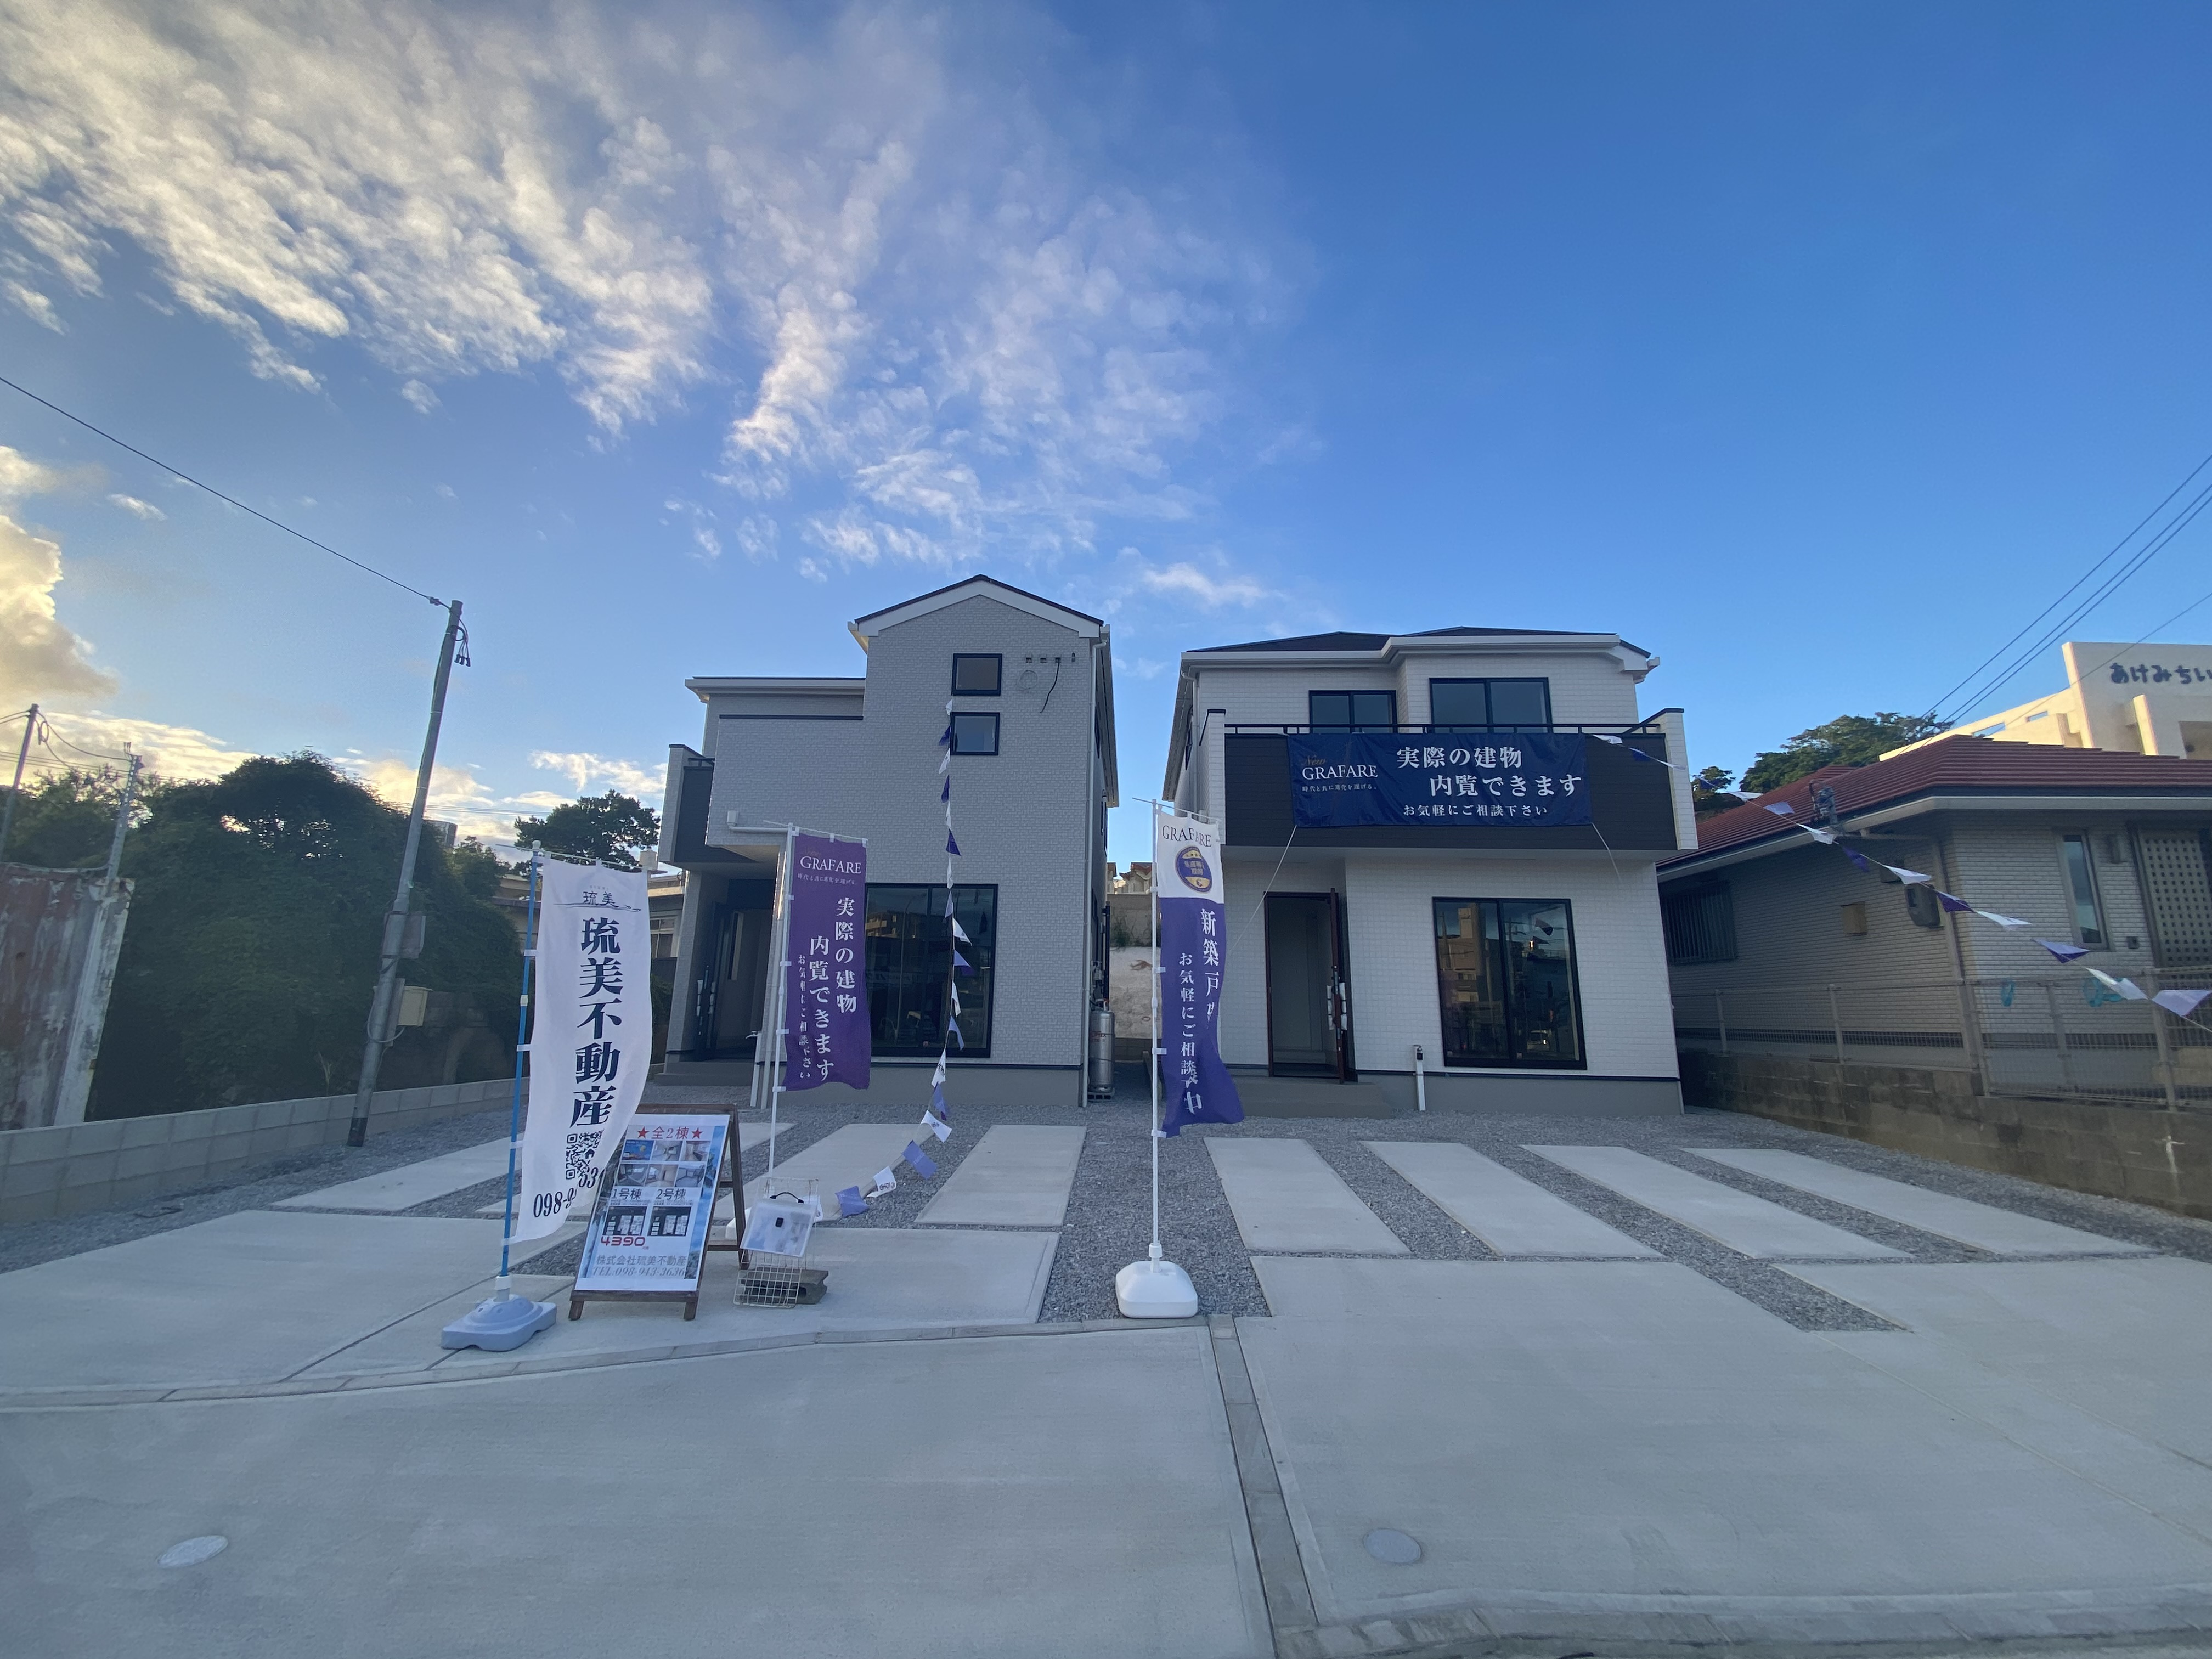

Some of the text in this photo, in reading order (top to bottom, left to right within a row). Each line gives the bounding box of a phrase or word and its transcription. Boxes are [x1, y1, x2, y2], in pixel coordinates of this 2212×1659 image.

[1397, 747, 1522, 769] 実際の建物
[1302, 765, 1378, 780] GRAFARE
[1430, 774, 1582, 797] 内覧できます
[1403, 804, 1548, 817] お気軽にご相談下さい
[1162, 825, 1212, 847] GRAFARE
[800, 856, 861, 874] GRAFARE
[835, 897, 857, 1014] 実際の建物
[809, 935, 834, 1082] 内覧できます
[569, 917, 624, 1128] 琉美不動産
[611, 1188, 686, 1200] 1号棟 2号棟
[601, 1236, 646, 1246] 4390
[596, 1255, 687, 1266] 株式会社琉美不動産
